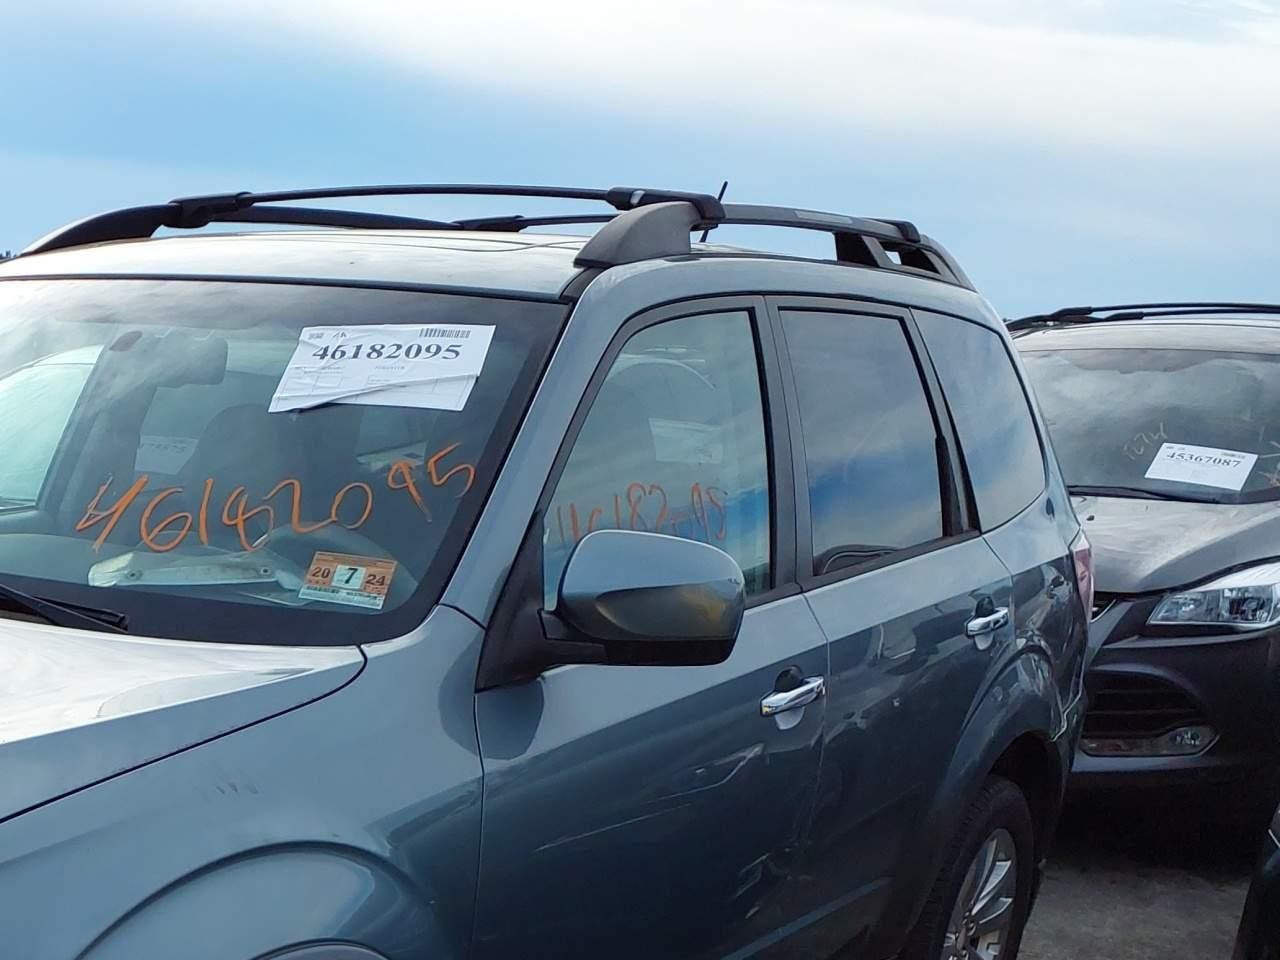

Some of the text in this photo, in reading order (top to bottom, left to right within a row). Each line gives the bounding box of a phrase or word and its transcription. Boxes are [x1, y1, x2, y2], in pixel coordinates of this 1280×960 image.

[312, 343, 462, 361] 46182095
[1166, 451, 1243, 468] 45367087
[76, 442, 476, 553] 46182095
[311, 567, 386, 586] 20 7 24
